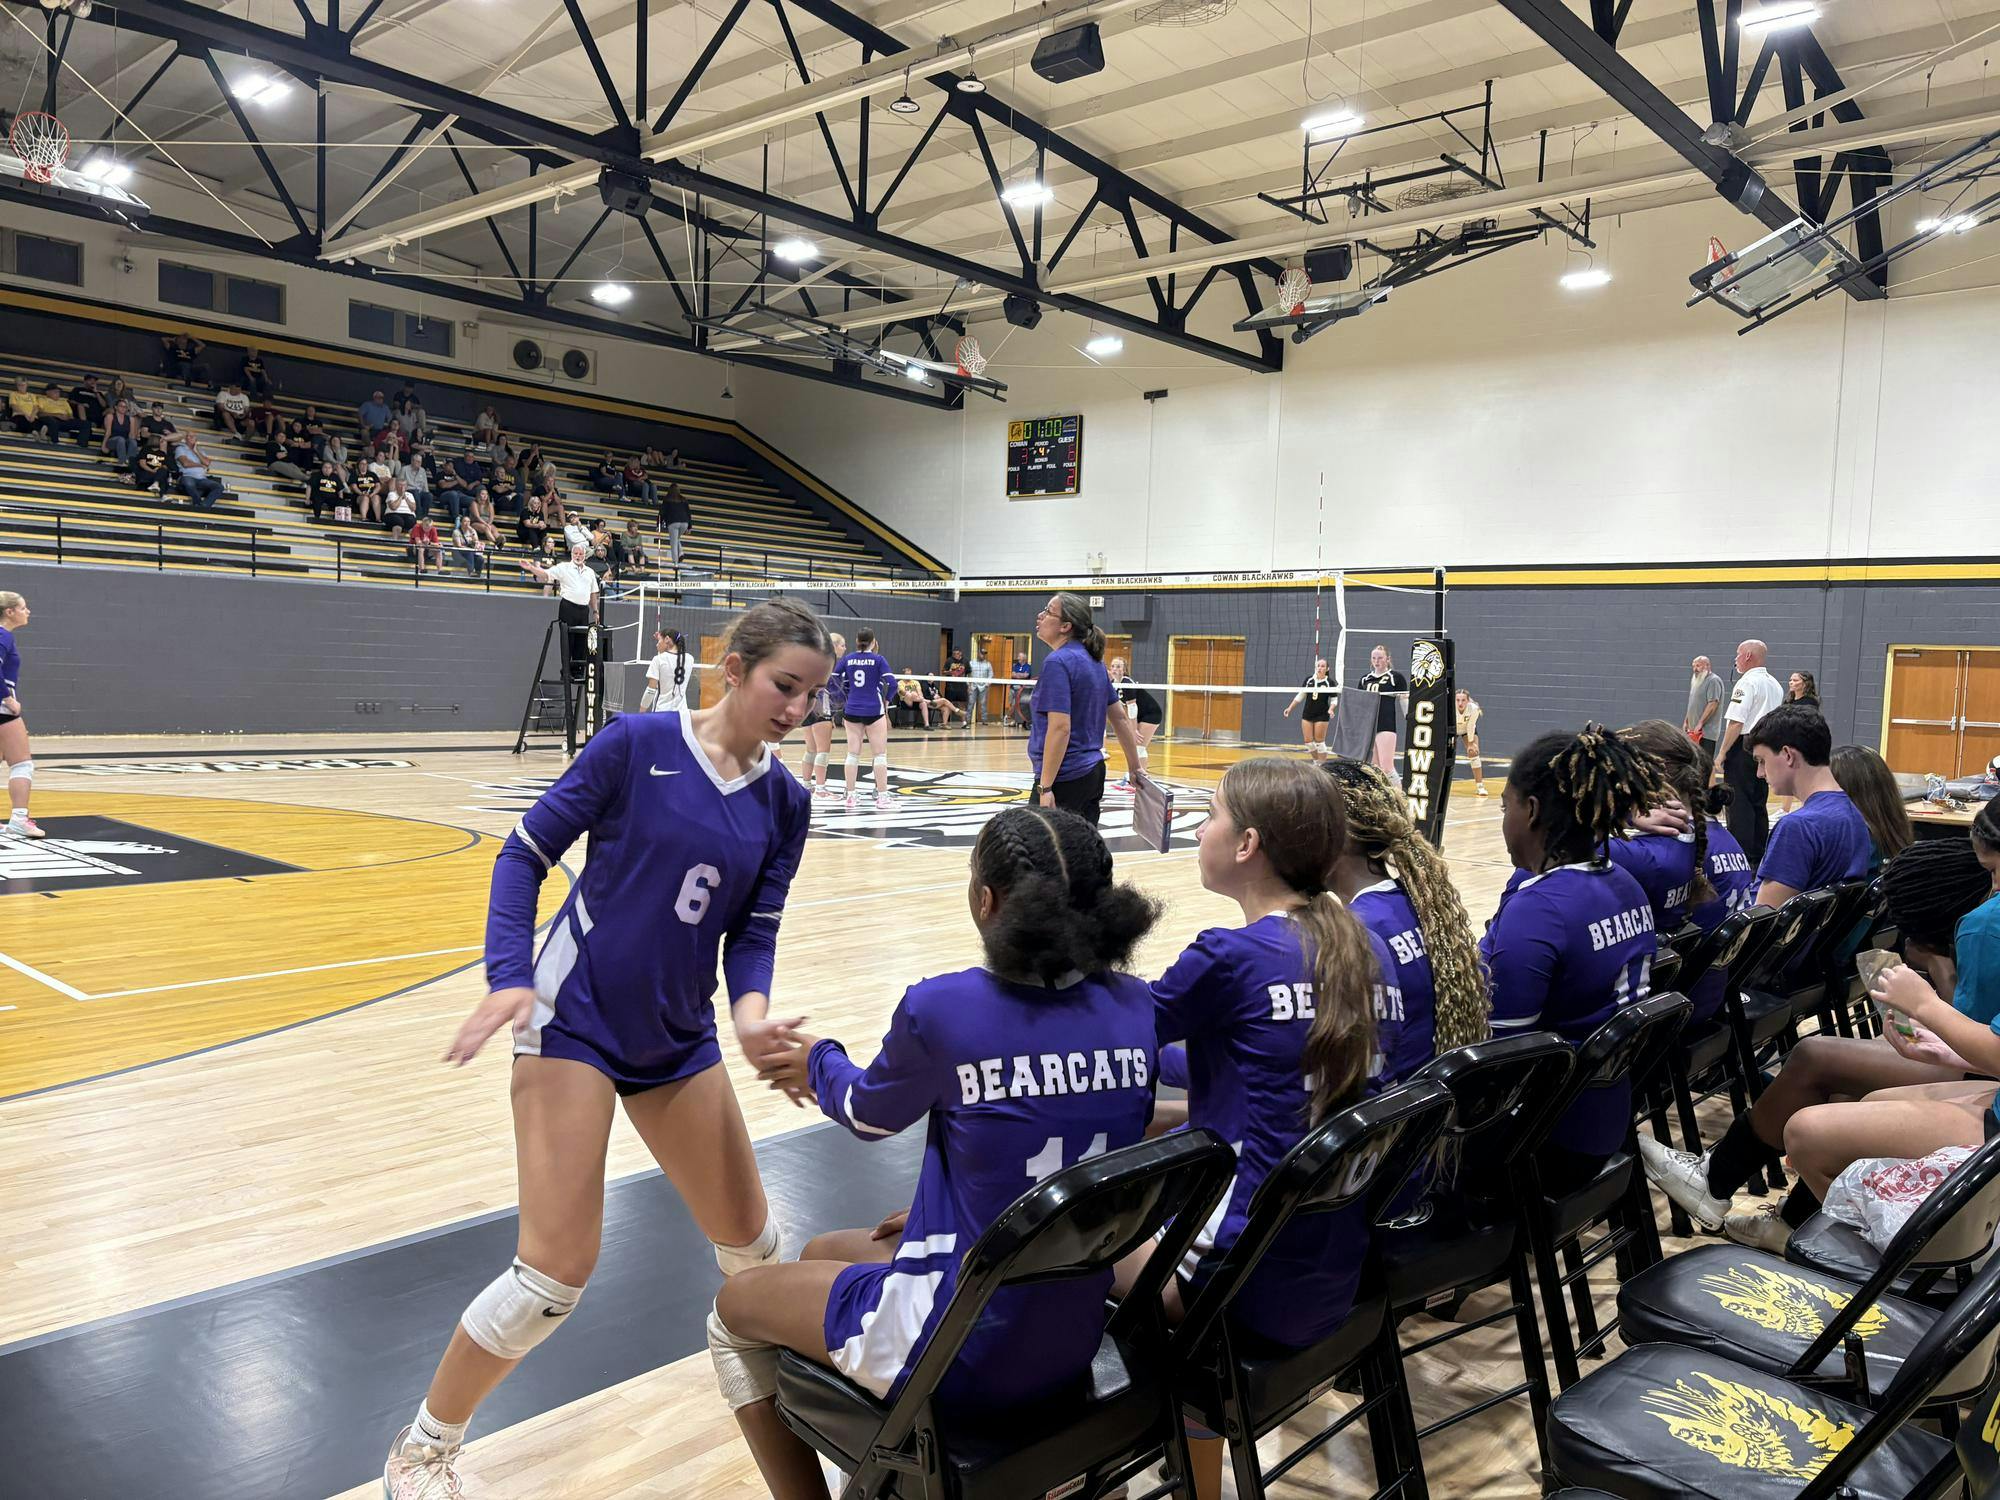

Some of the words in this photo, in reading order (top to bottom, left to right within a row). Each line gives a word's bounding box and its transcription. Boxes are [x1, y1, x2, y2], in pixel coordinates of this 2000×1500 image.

[1117, 577, 1162, 585] BLACKHAWKS
[1212, 574, 1239, 582] COWAN
[1241, 572, 1294, 581] BLACKHAWKS
[586, 663, 596, 737] COWAN
[854, 669, 866, 688] 9
[1407, 701, 1435, 820] COWAN
[674, 863, 721, 925] 6
[1267, 982, 1405, 1022] BEATS
[956, 1048, 1148, 1105] BEARCATS
